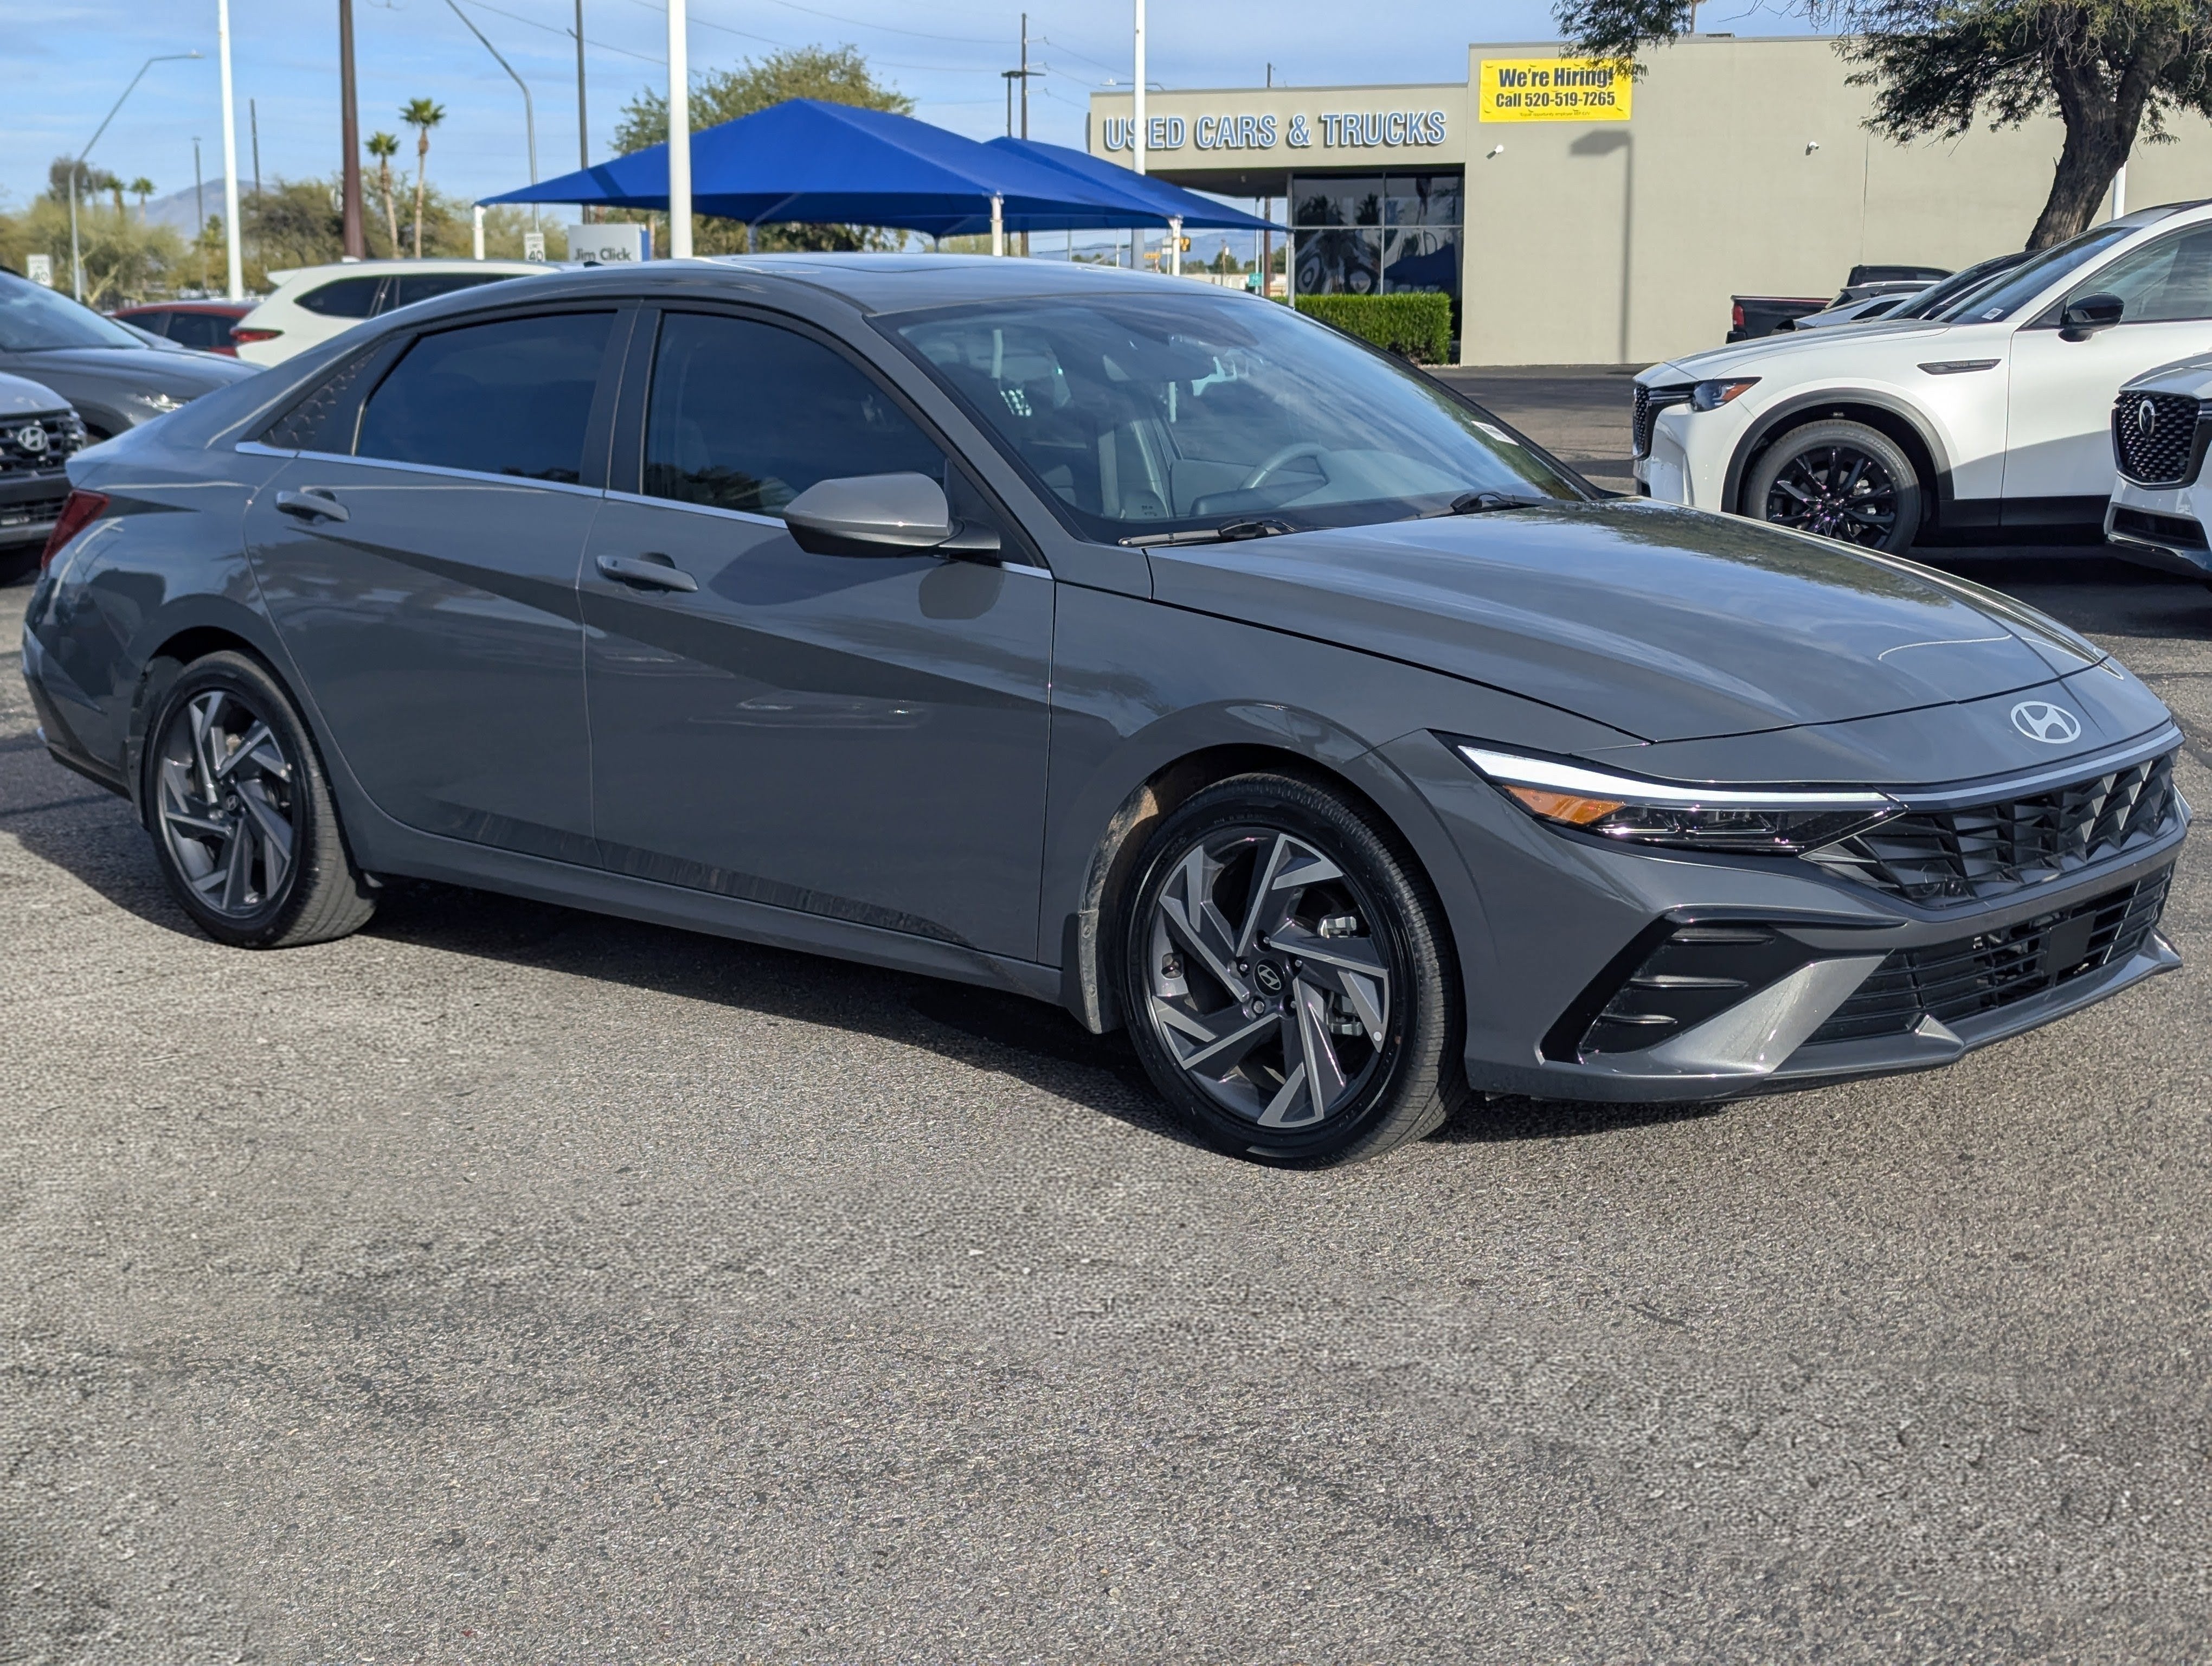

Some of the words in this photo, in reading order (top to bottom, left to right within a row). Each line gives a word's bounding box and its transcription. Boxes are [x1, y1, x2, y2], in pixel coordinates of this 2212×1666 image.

[1499, 68, 1549, 87] We're
[1554, 67, 1613, 88] Hiring!
[1496, 93, 1521, 107] Call
[1525, 92, 1615, 107] 520-519-7265
[1196, 114, 1278, 148] CARS
[1289, 114, 1311, 146] &
[1321, 111, 1446, 145] TRUCKS
[575, 248, 596, 261] Jim
[600, 247, 632, 261] Click
